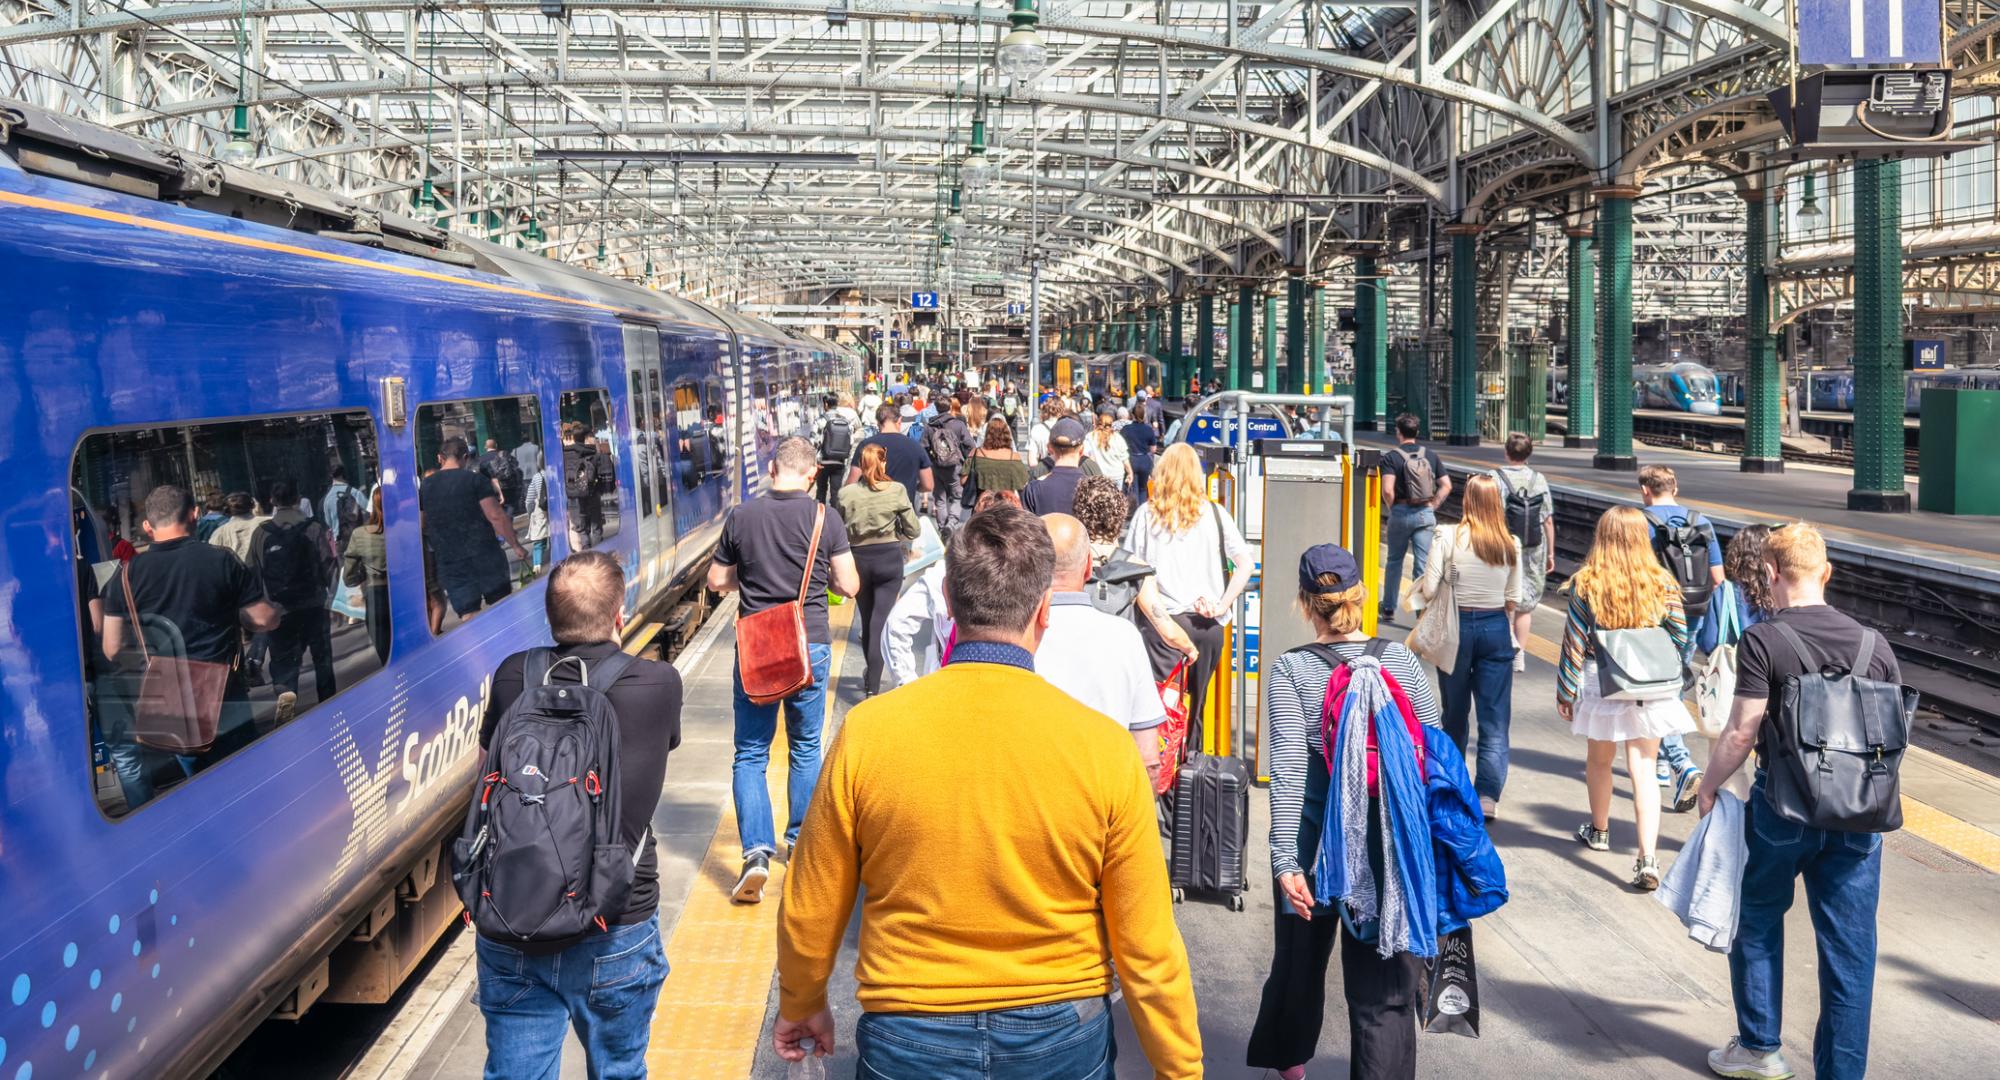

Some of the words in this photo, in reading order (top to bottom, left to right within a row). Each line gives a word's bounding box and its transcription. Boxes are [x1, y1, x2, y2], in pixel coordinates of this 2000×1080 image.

[1850, 0, 1903, 58] 11
[917, 294, 932, 307] 12
[1011, 304, 1021, 314] 11
[900, 341, 908, 349] 12
[1212, 420, 1247, 432] Glgo
[1248, 422, 1277, 432] Central
[395, 673, 491, 815] ScotRail
[1445, 937, 1468, 959] M&S
